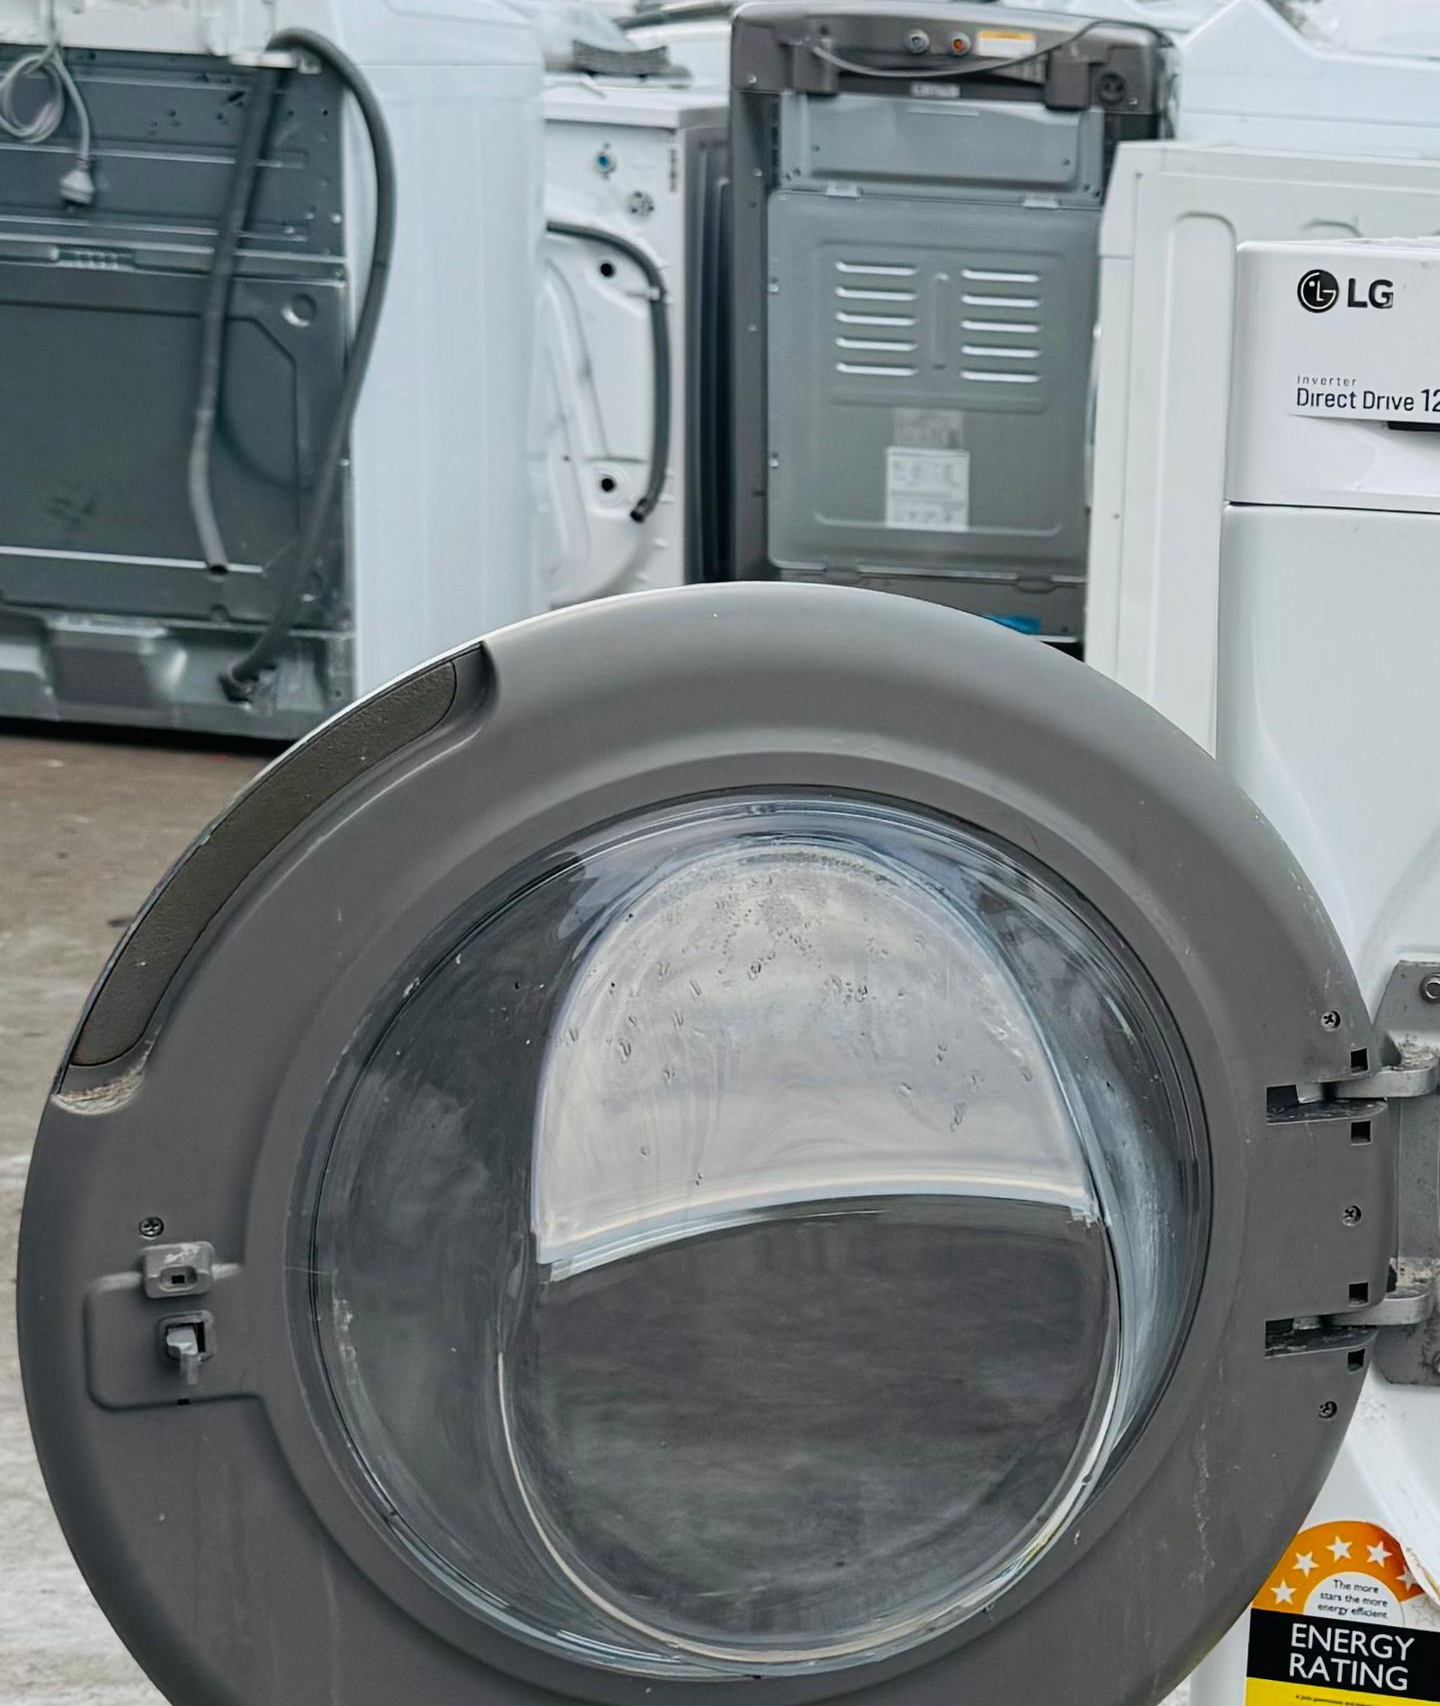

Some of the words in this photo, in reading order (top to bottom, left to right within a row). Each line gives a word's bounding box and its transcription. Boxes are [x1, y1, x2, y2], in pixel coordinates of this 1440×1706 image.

[1347, 278, 1394, 309] LG
[1297, 374, 1356, 387] Inverter
[1296, 387, 1357, 409] Direct
[1363, 390, 1414, 411] Drive
[1333, 1579, 1351, 1591] The
[1353, 1584, 1379, 1593] more
[1320, 1592, 1342, 1602] stars
[1345, 1594, 1360, 1604] the
[1363, 1598, 1388, 1608] more
[1318, 1604, 1349, 1616] energy
[1351, 1606, 1388, 1619] efficient
[1291, 1622, 1415, 1661] ENERGY
[1289, 1652, 1409, 1691] RATING
